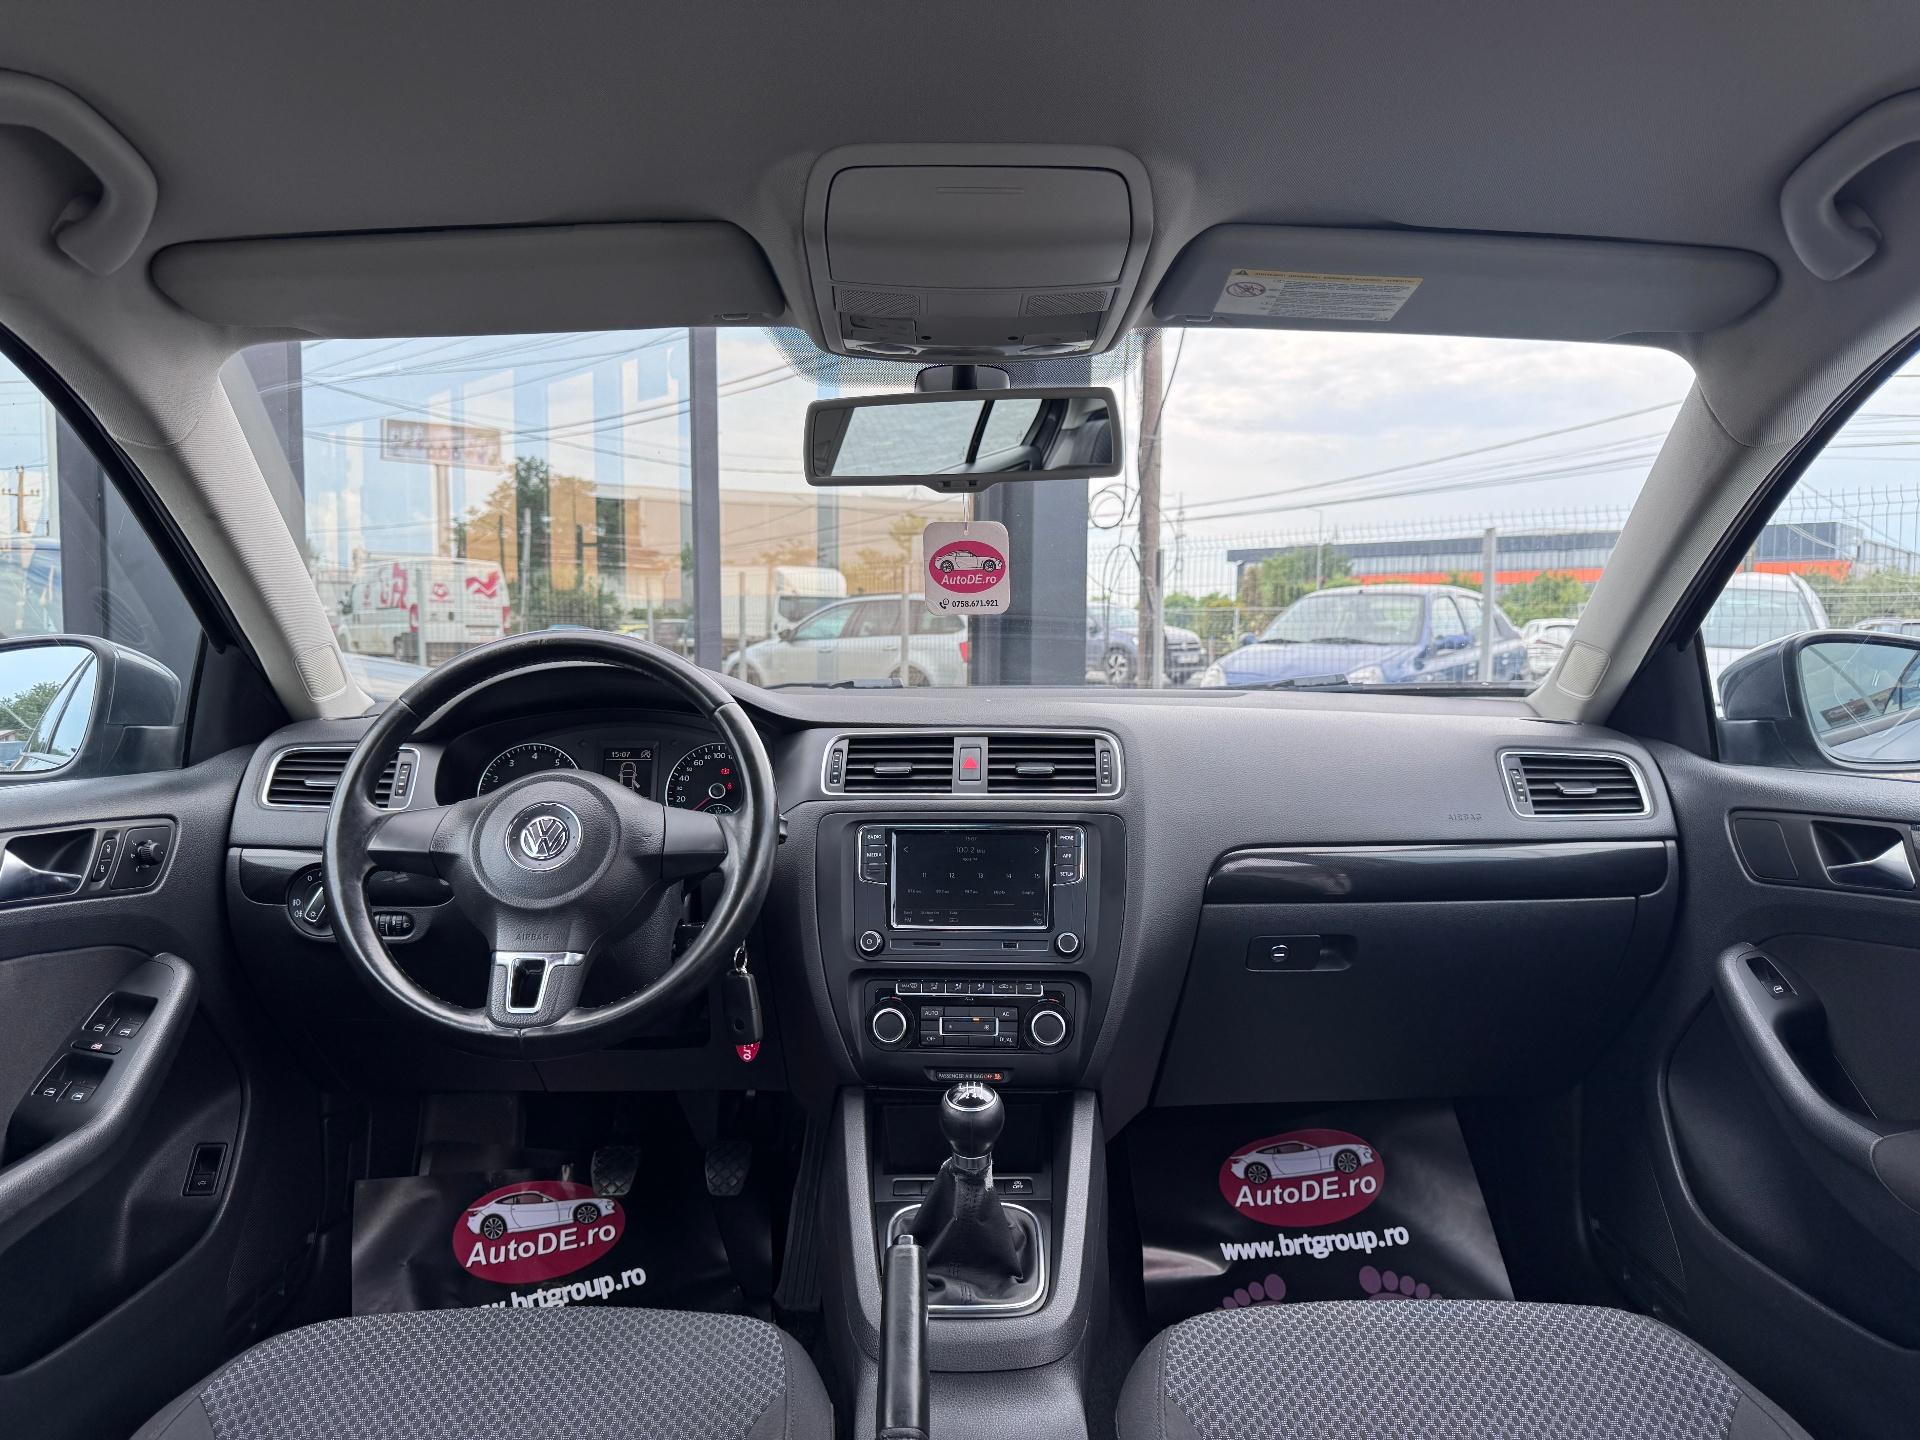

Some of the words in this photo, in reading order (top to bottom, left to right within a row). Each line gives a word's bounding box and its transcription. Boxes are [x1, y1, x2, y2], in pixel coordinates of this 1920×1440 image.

[941, 574, 997, 585] AutoDE.ro
[951, 599, 999, 608] 0758.671.921
[531, 752, 538, 760] 4
[509, 759, 515, 767] 3
[554, 759, 560, 767] 5
[676, 795, 686, 803] 20
[515, 933, 550, 942] AIRBAG
[1235, 1175, 1377, 1207] AutoDE.ro
[465, 1225, 616, 1268] AutoDE.ro
[1220, 1225, 1410, 1260] www.brtgroup.ro
